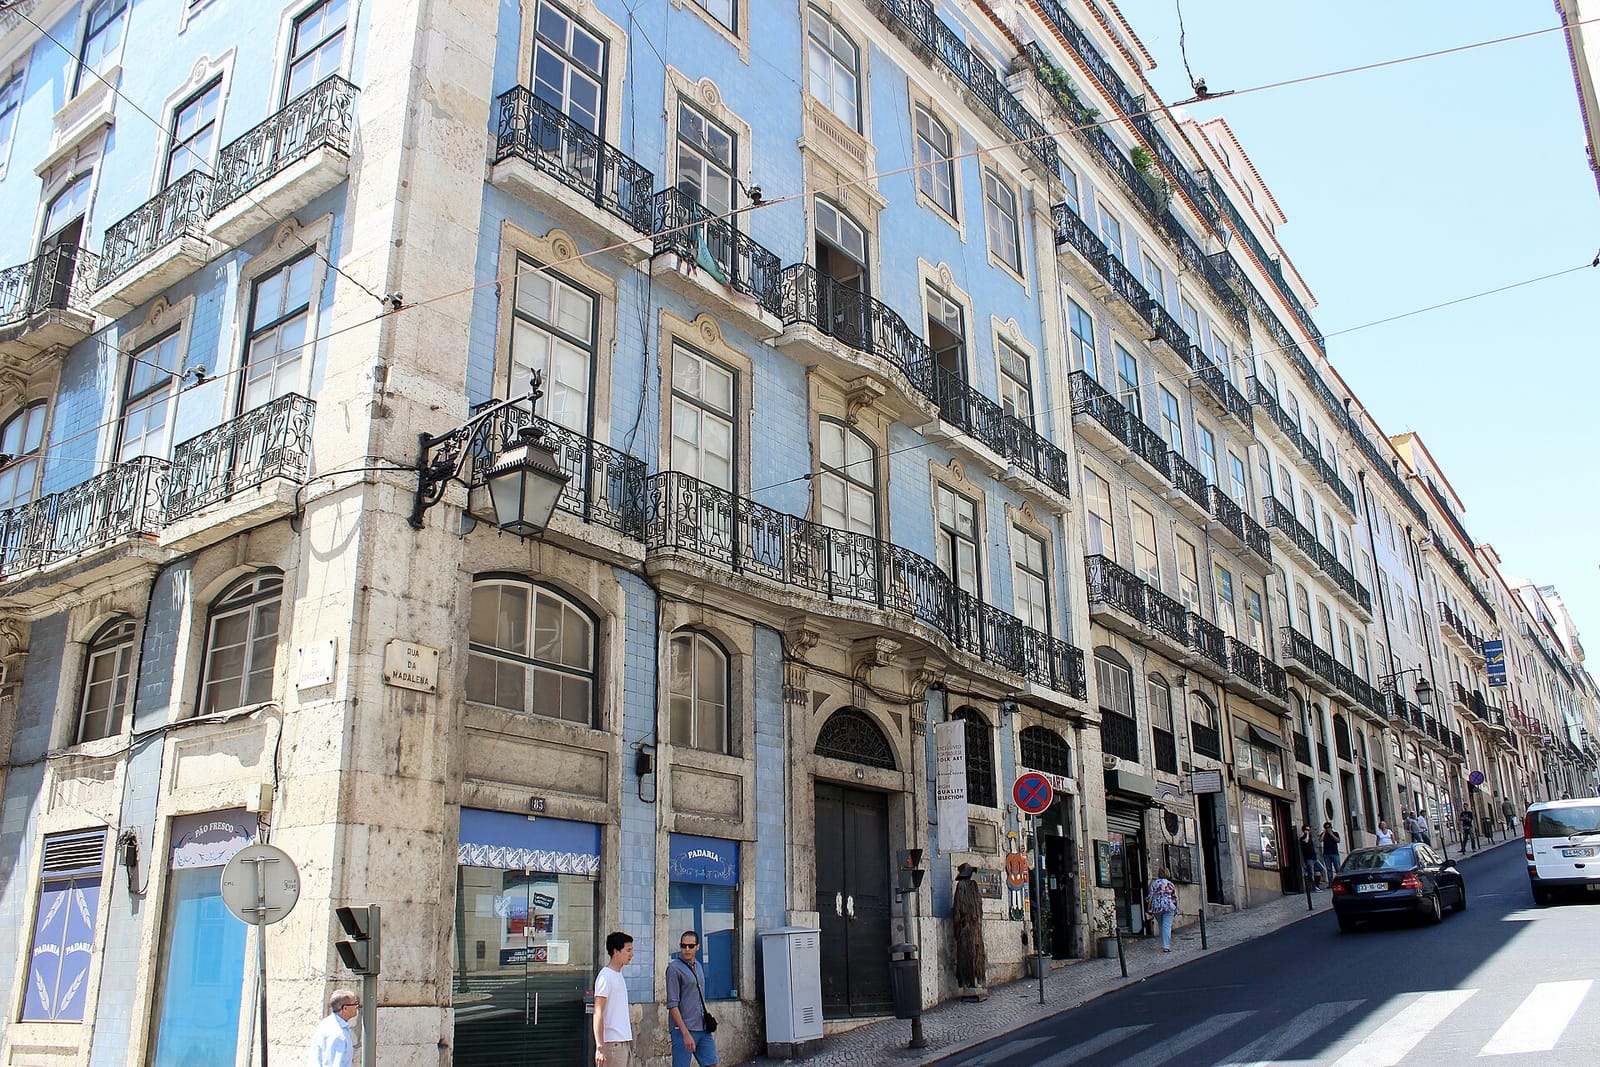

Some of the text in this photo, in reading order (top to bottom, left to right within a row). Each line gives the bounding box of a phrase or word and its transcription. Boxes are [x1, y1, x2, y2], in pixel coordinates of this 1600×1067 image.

[407, 647, 420, 657] RUA
[407, 660, 417, 670] DA
[392, 670, 429, 685] MADALENA
[209, 821, 234, 833] FRESCO
[687, 849, 719, 862] PADARIA
[34, 943, 60, 957] PADARIA
[66, 942, 93, 956] PADARIA
